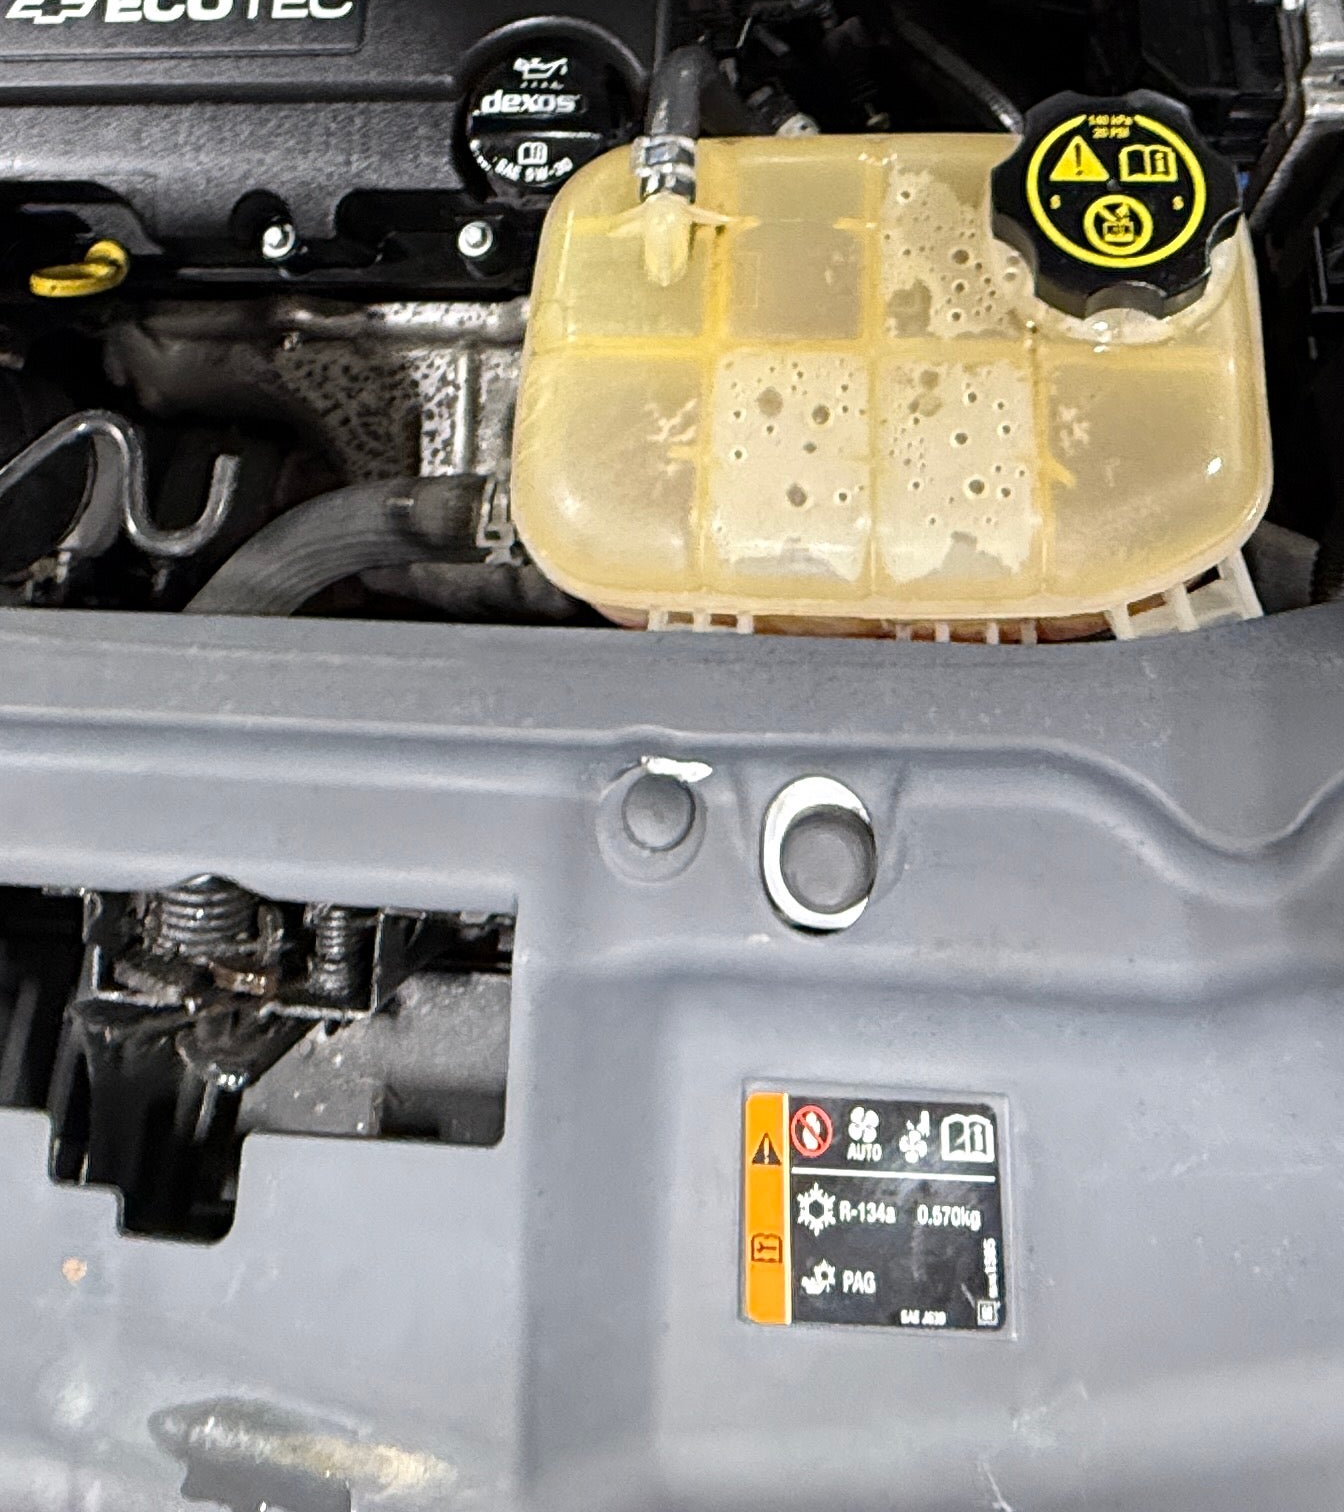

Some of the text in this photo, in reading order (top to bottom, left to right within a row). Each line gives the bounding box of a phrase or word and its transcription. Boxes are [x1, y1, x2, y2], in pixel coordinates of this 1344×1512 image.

[480, 88, 578, 113] dexos
[494, 157, 523, 181] SAE
[846, 1143, 882, 1162] AUTO
[838, 1200, 896, 1224] R-134a
[842, 1270, 876, 1293] PAG
